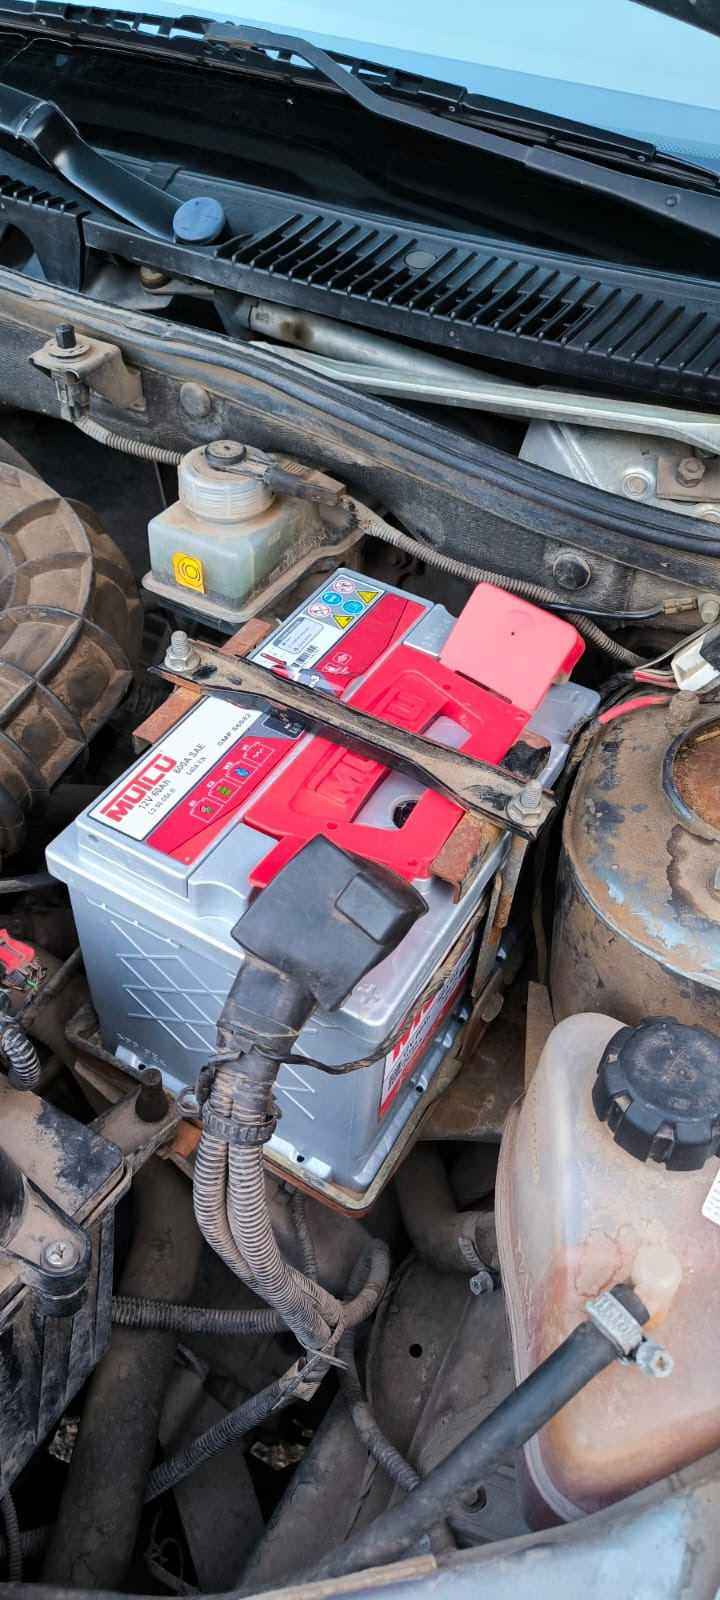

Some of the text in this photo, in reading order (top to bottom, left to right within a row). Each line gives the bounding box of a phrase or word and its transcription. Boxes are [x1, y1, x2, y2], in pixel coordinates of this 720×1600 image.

[100, 752, 178, 822] MUTLU
[138, 796, 154, 810] 12V
[151, 779, 172, 796] 60Ah
[189, 743, 206, 758] SAE
